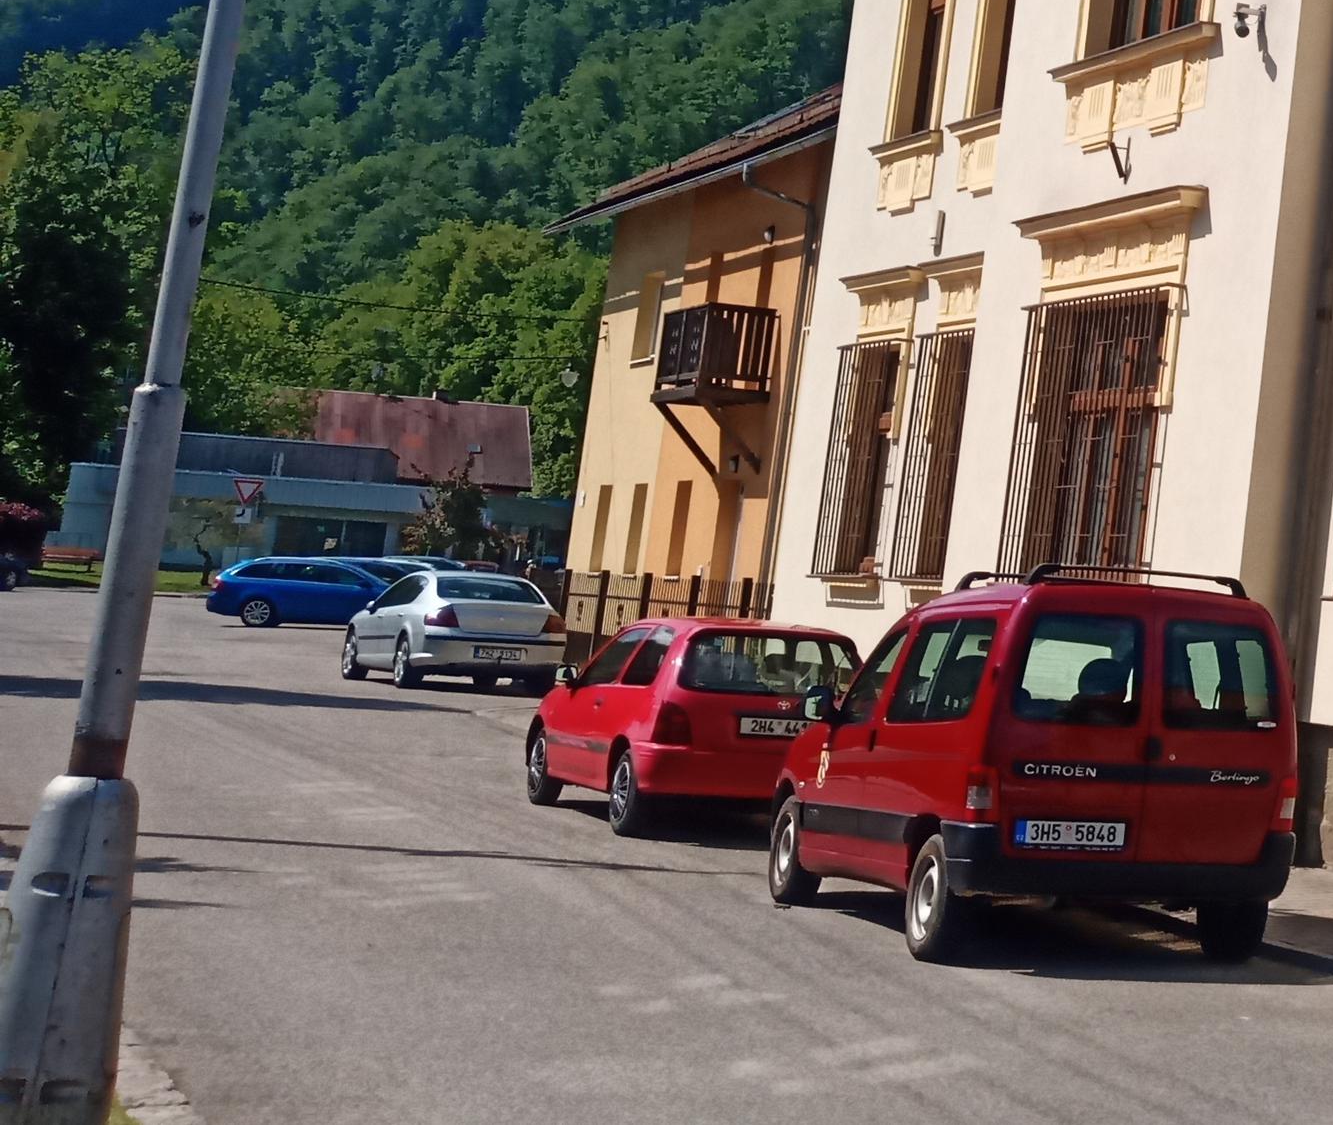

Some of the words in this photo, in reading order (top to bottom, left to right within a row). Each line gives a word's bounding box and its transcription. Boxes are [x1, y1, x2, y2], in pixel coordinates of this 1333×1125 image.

[751, 719, 774, 732] 2H4
[1209, 770, 1260, 784] Berlingo
[1030, 823, 1061, 841] 3H5
[1074, 824, 1117, 843] 5848
